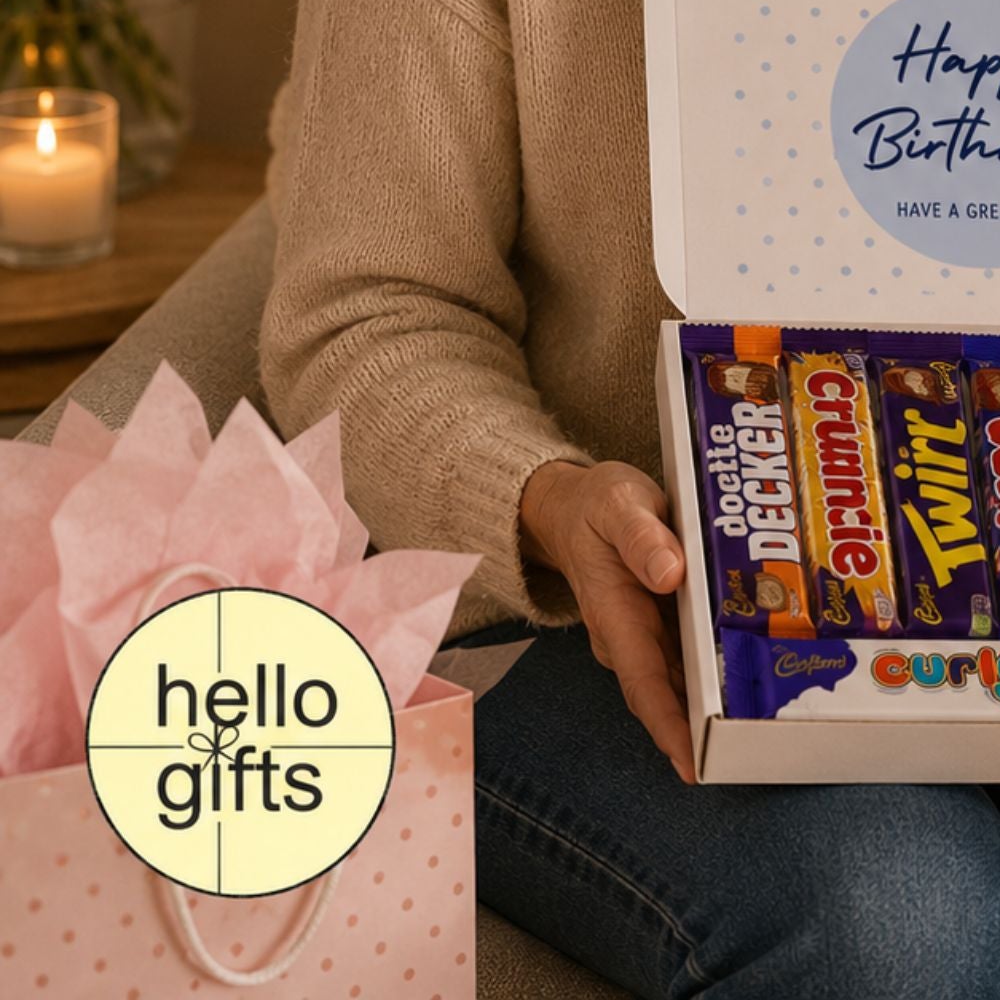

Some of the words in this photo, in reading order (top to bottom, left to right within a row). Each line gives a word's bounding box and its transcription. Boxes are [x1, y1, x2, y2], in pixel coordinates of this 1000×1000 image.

[896, 201, 942, 219] HAVE
[948, 202, 960, 219] A
[731, 401, 801, 564] DECKER
